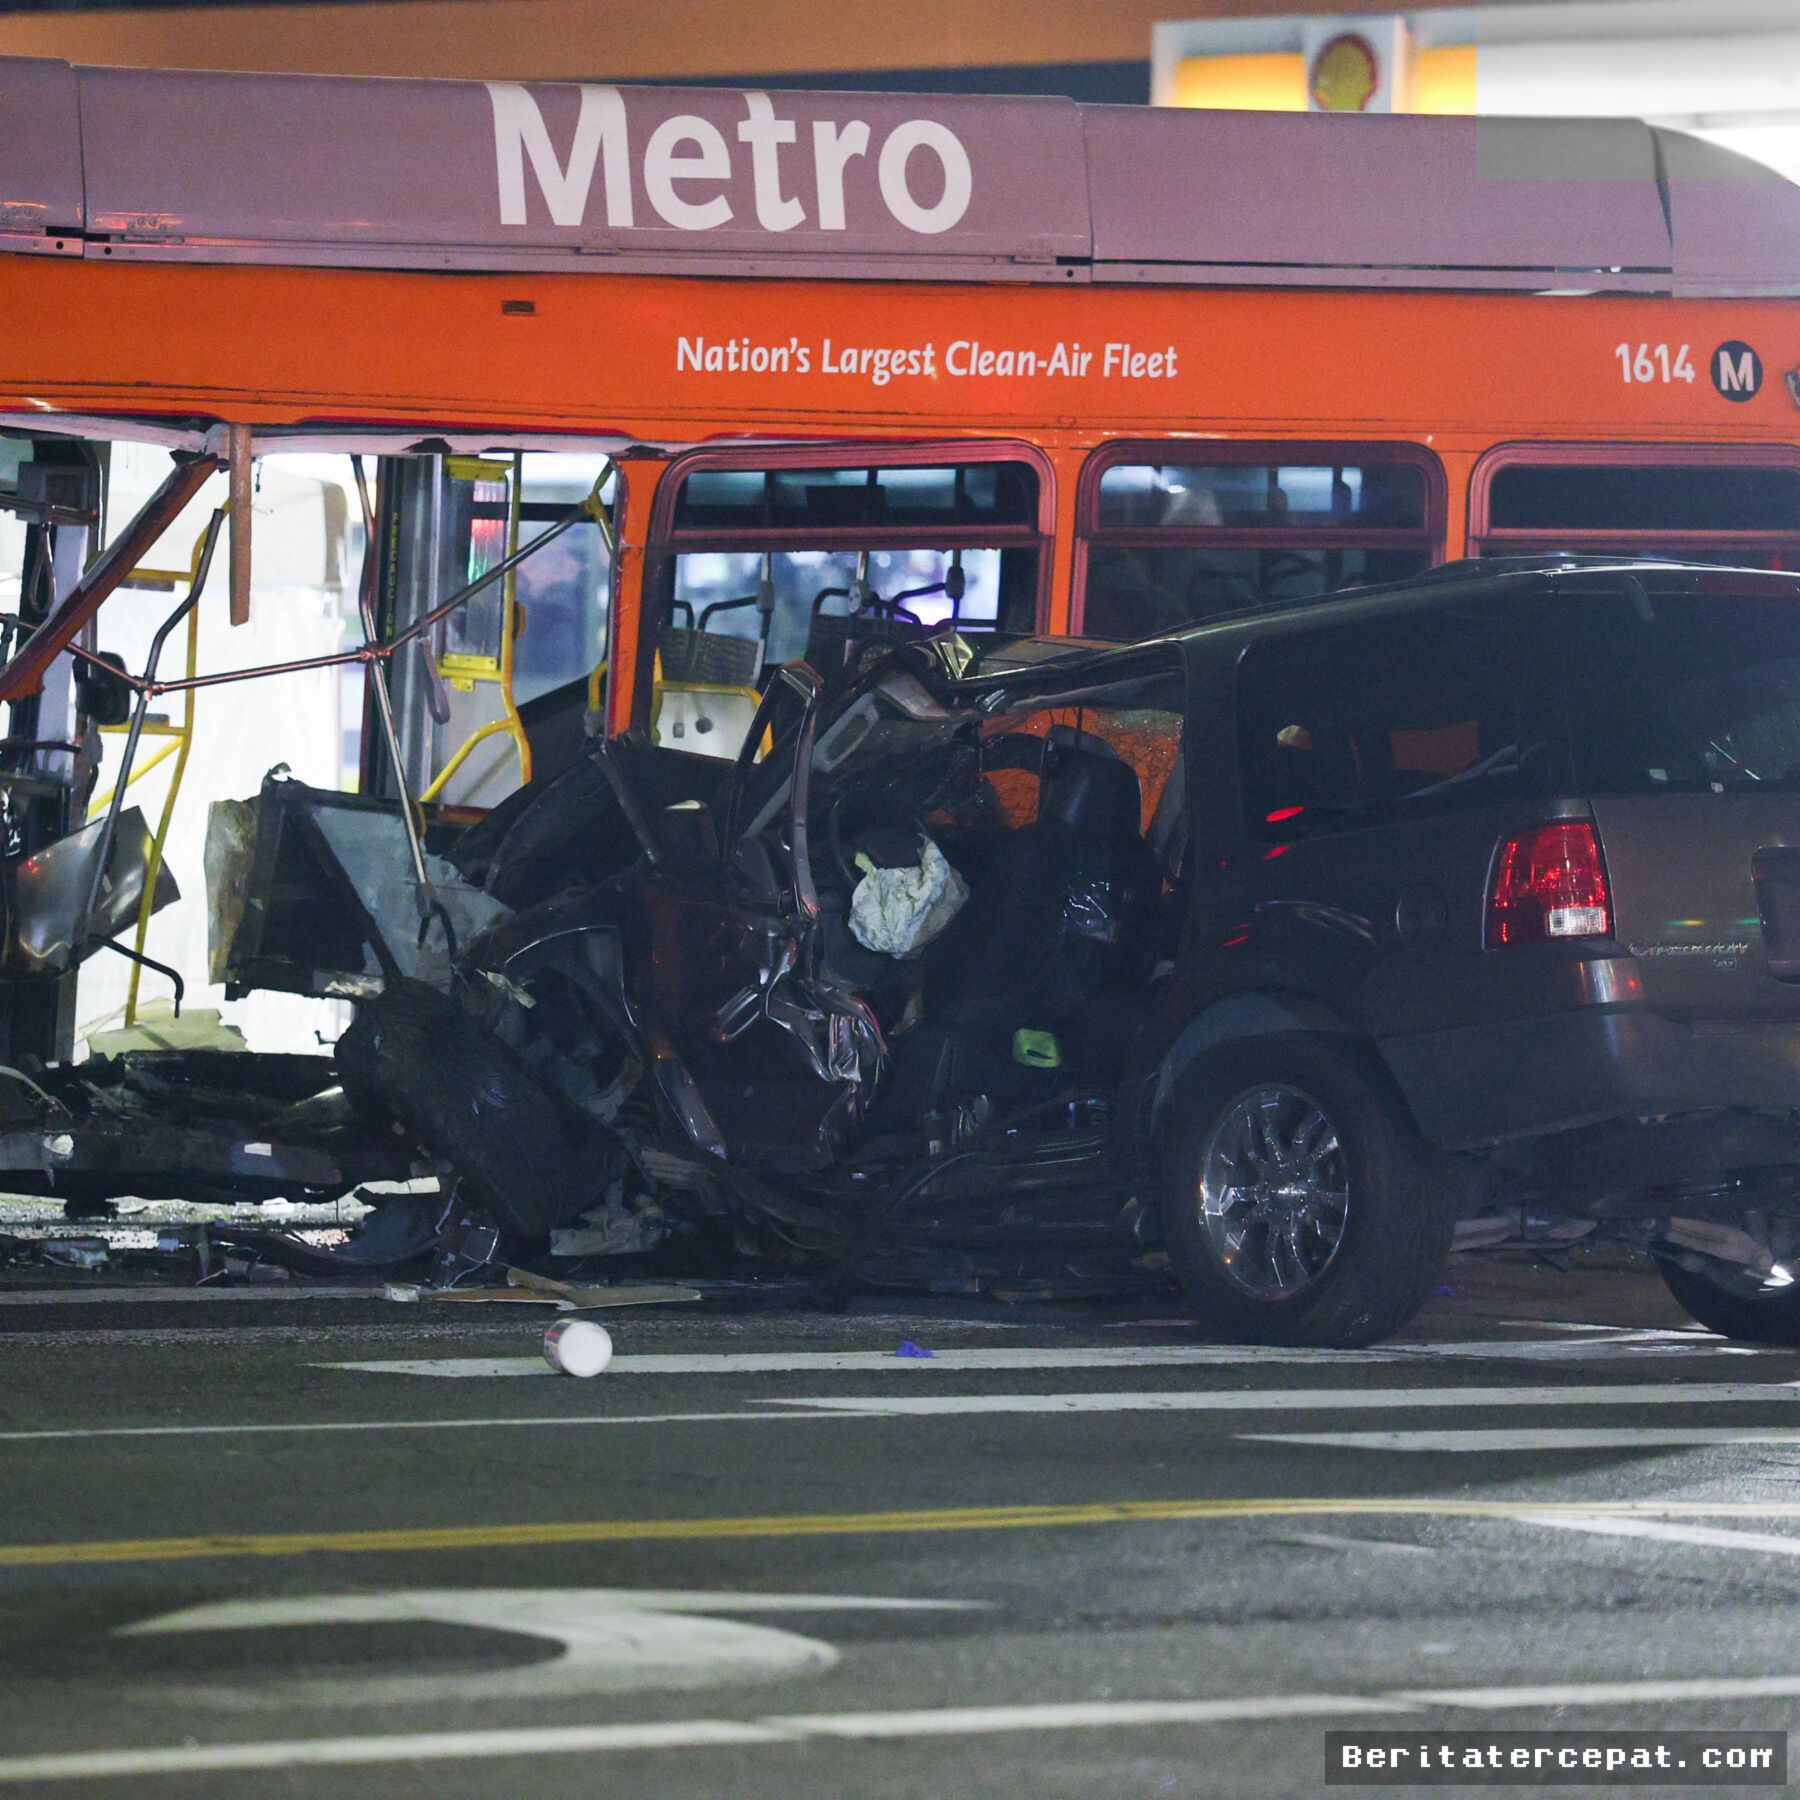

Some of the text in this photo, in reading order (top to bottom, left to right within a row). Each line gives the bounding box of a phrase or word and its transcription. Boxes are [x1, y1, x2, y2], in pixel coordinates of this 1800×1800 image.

[484, 82, 973, 234] Metro
[676, 336, 1178, 386] Nation's Largest Clean-Air Fleet
[1615, 343, 1696, 384] 1614
[1719, 350, 1755, 392] M
